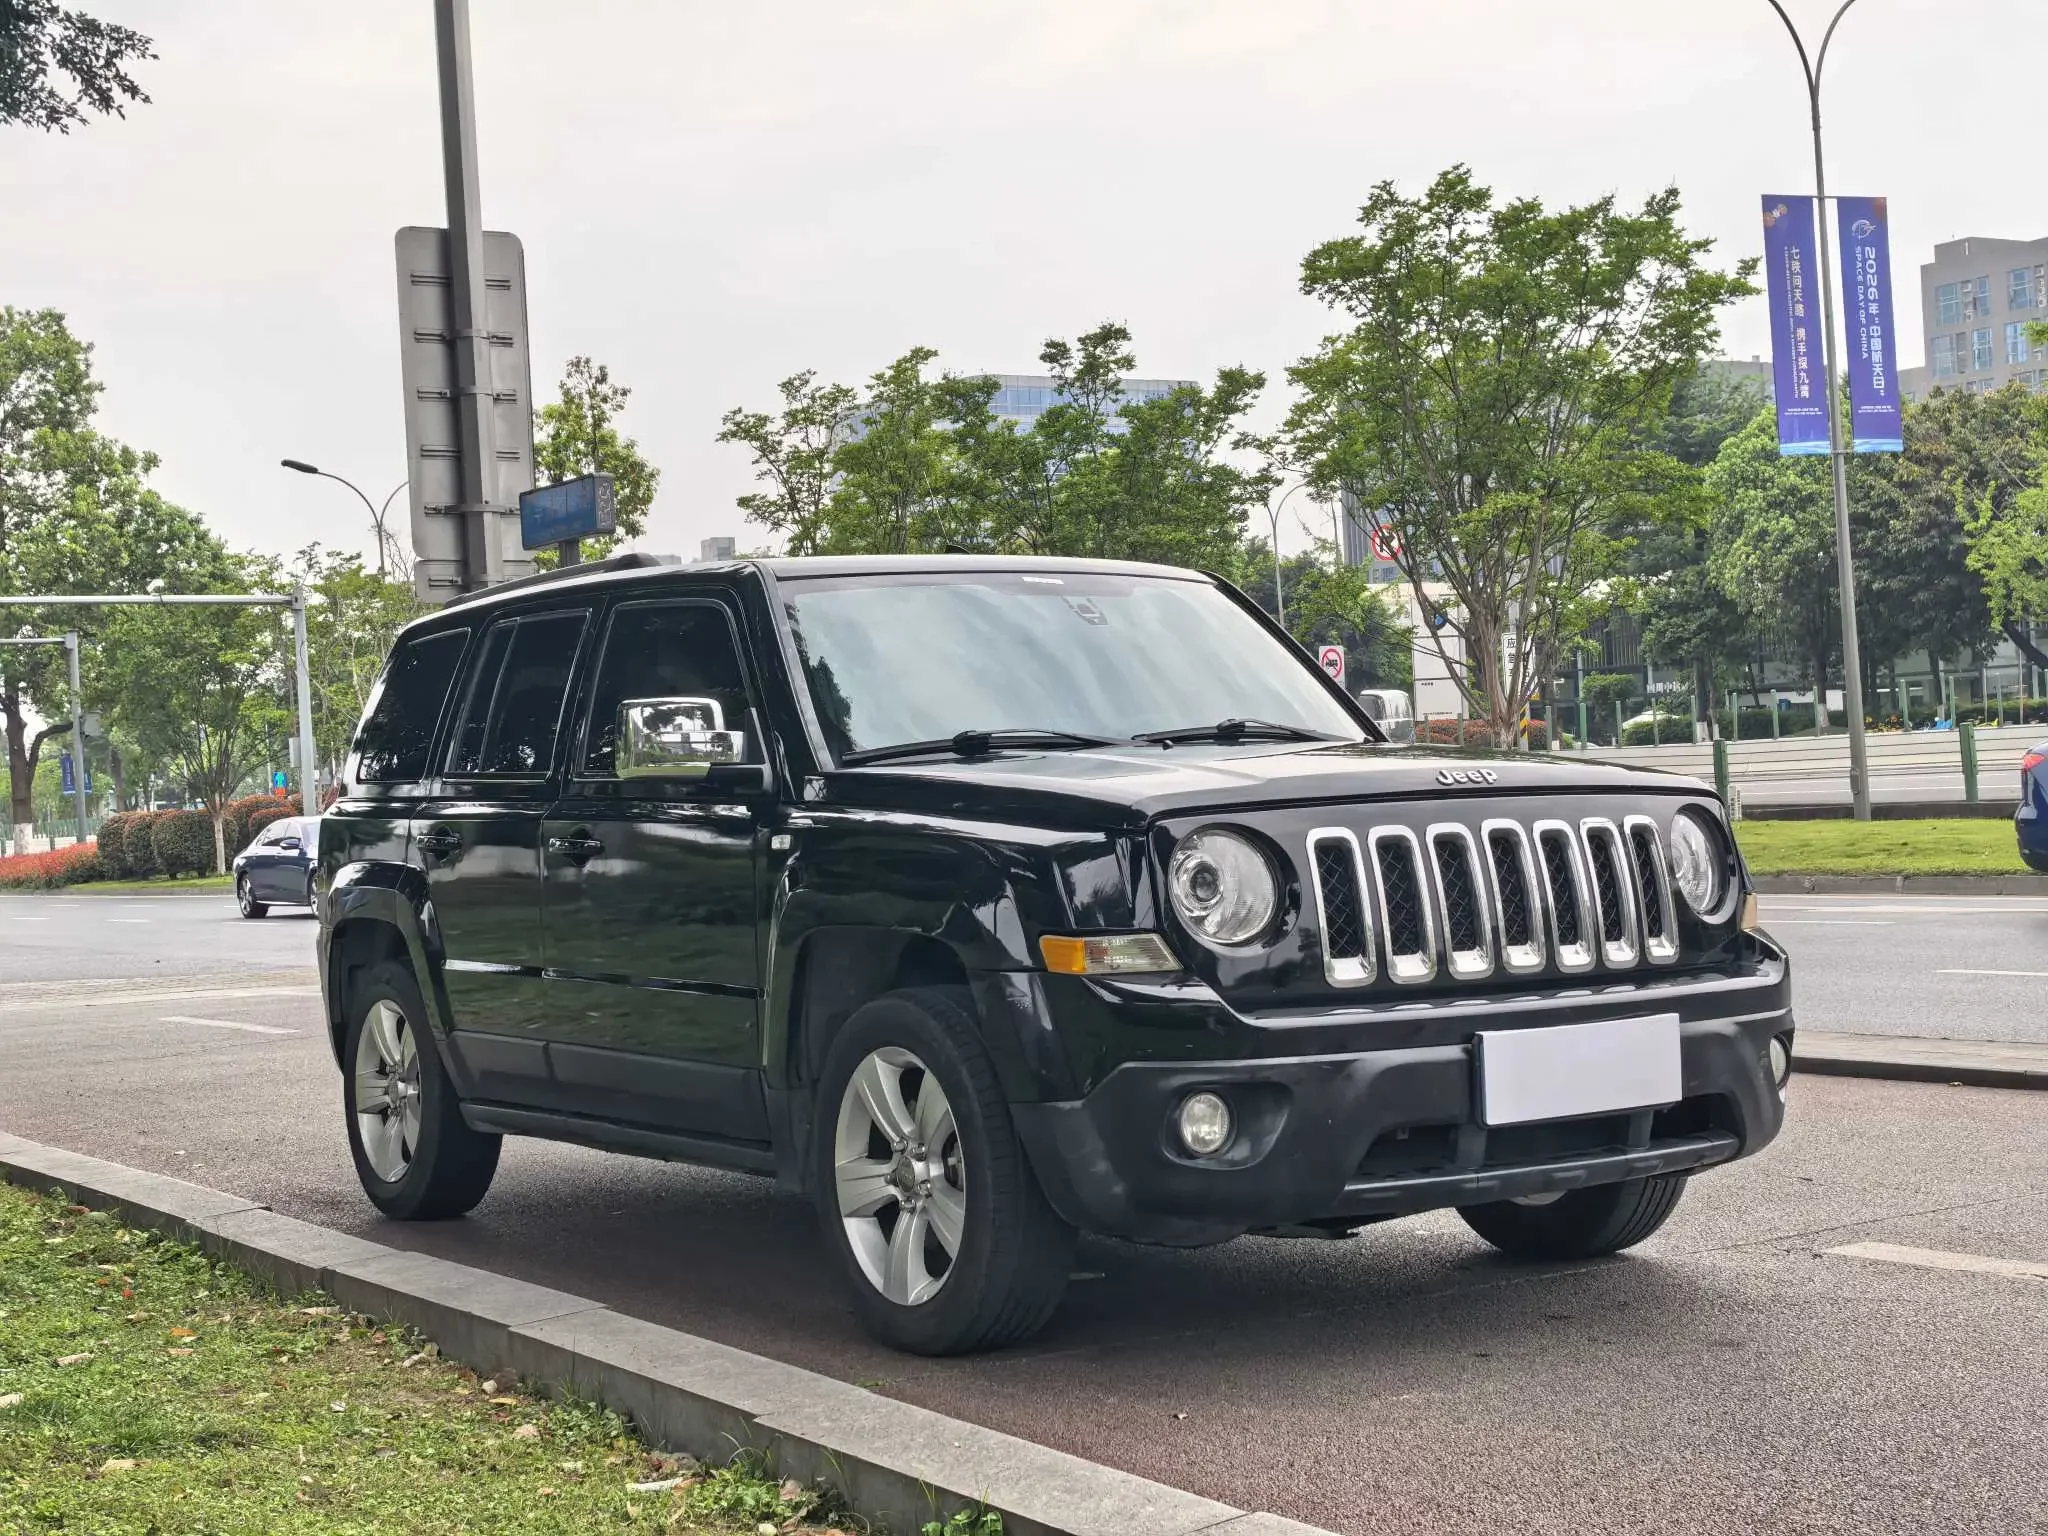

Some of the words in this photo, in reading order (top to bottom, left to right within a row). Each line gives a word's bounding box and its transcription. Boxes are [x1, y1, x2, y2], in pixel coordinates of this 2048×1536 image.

[1855, 245, 1864, 283] SPACE
[1857, 285, 1865, 308] DAY
[1859, 309, 1867, 325] OF
[1860, 327, 1869, 360] CHINA
[1436, 768, 1498, 786] Jeep
